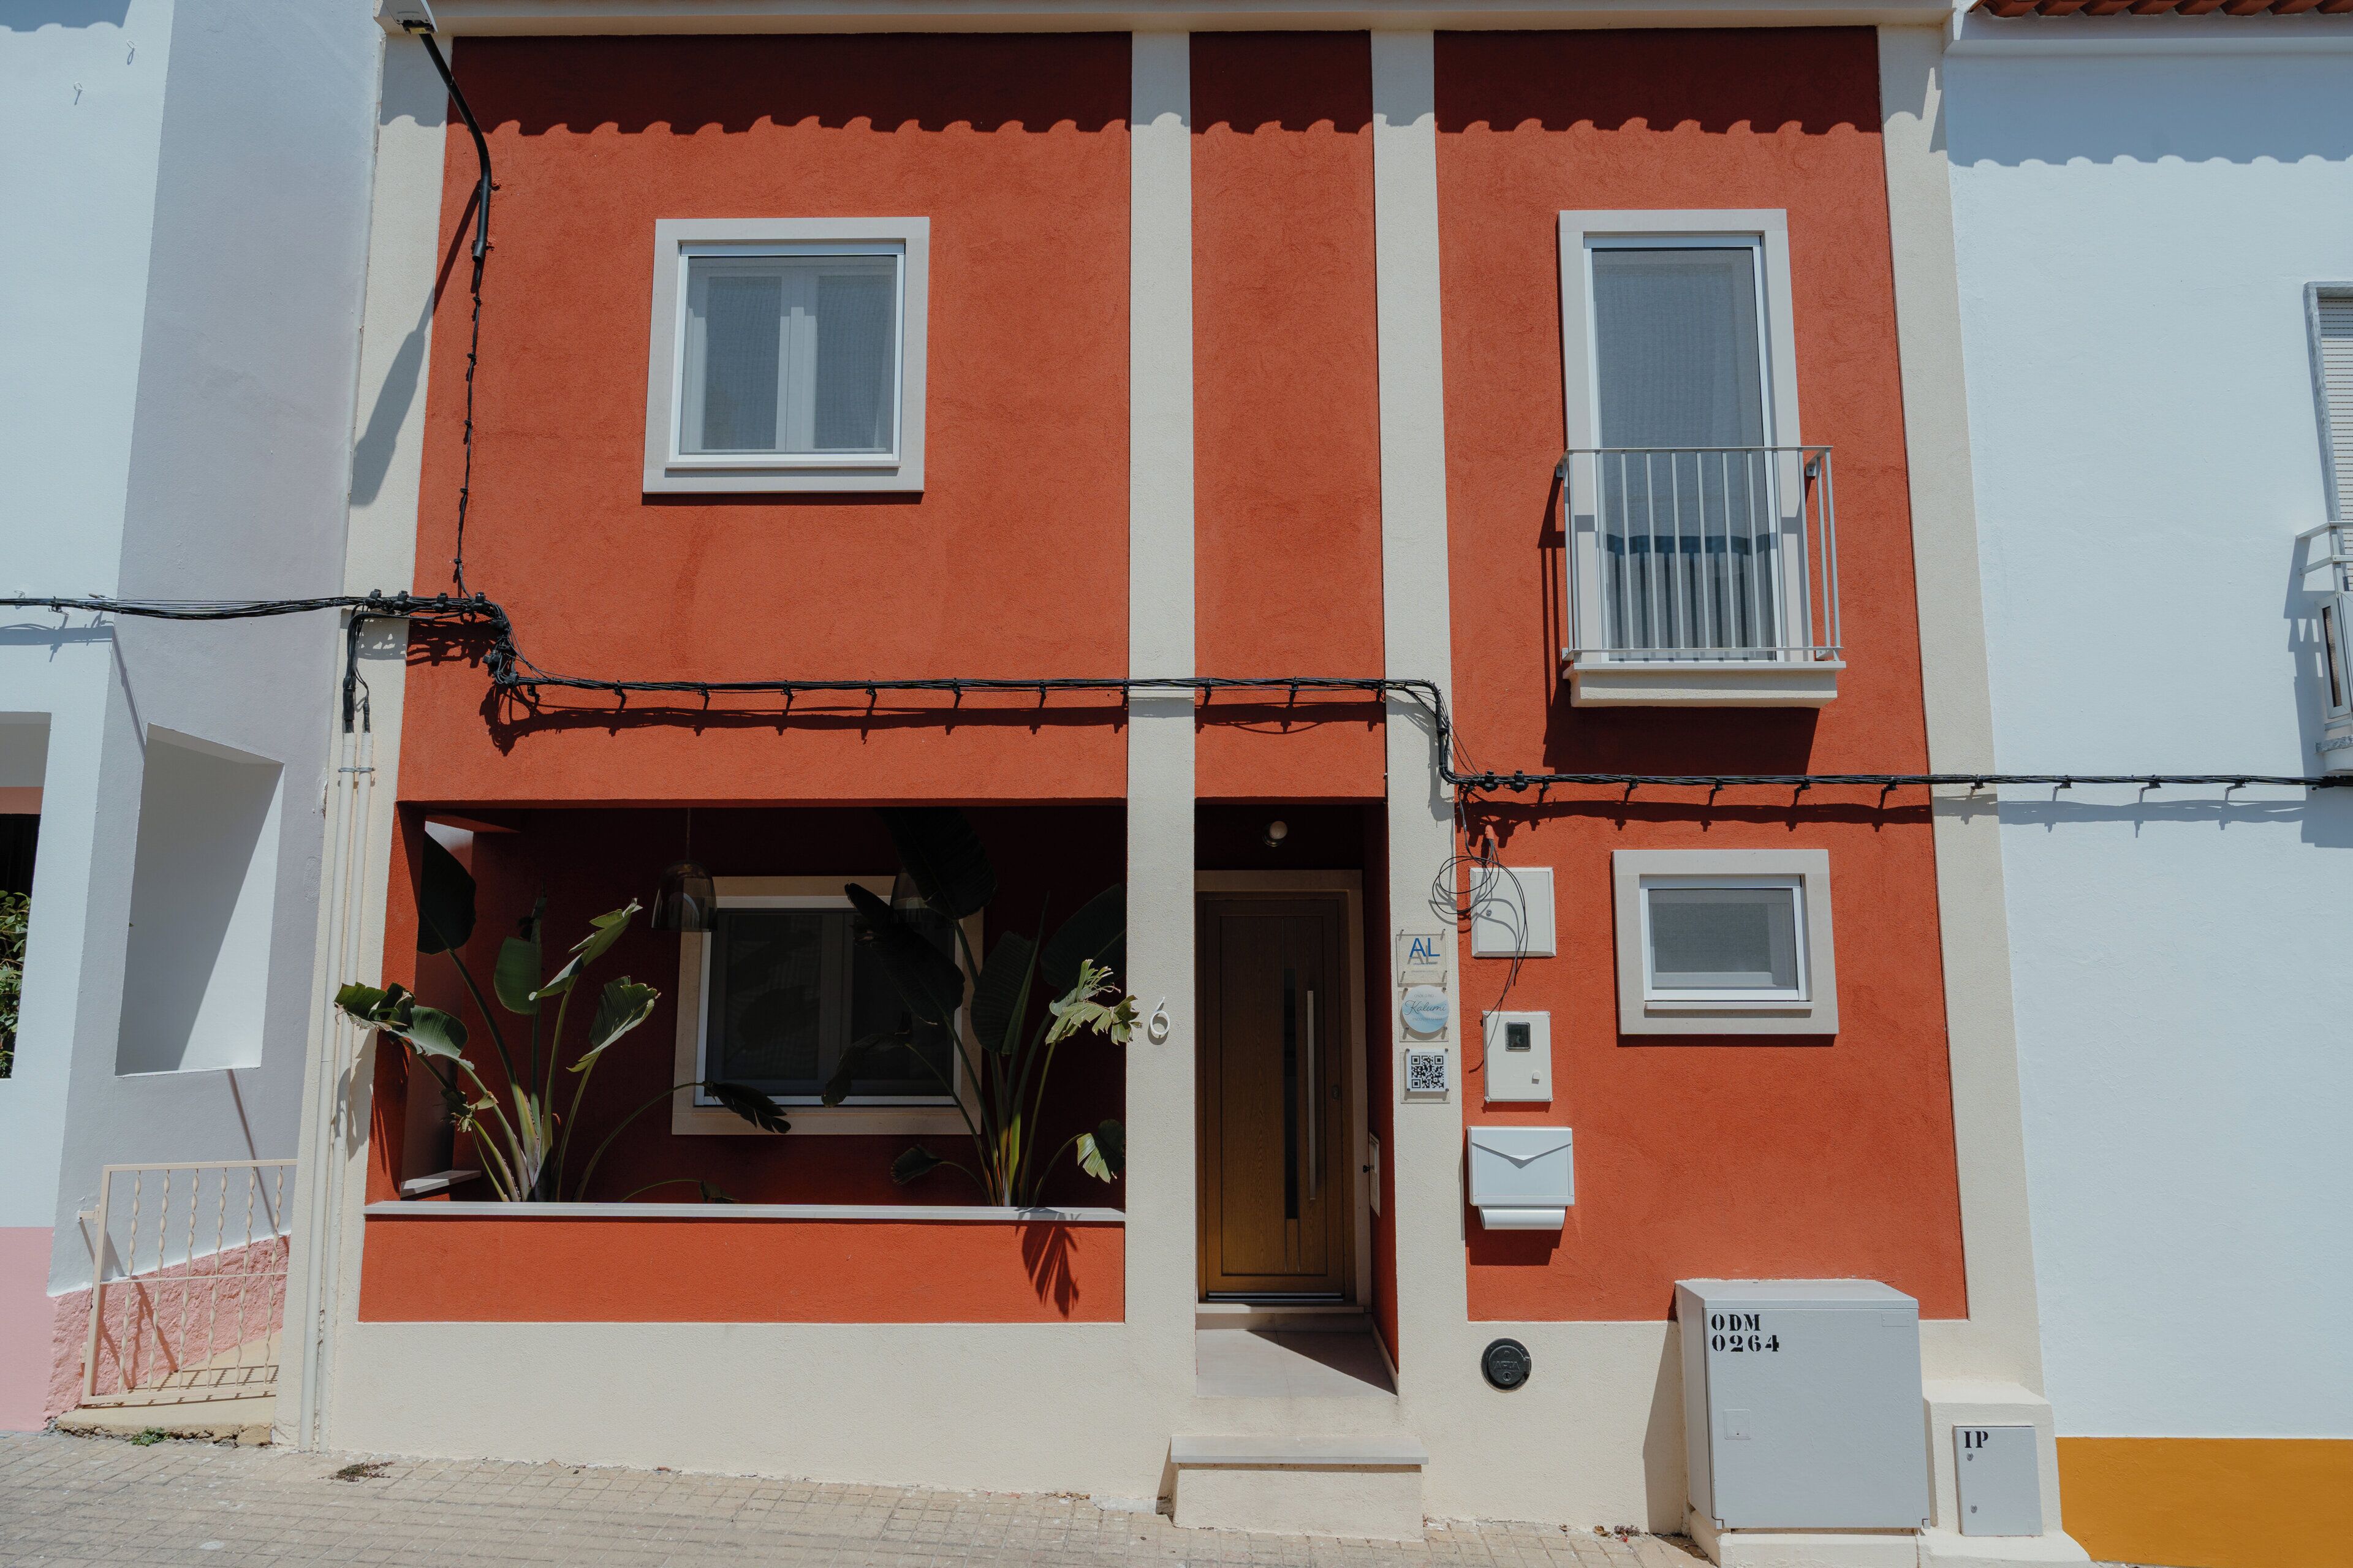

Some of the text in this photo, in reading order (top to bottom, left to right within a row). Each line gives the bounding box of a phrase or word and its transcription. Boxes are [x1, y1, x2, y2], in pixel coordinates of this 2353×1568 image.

[1409, 937, 1441, 958] AL
[1404, 1000, 1447, 1015] Kalumi
[1150, 996, 1170, 1037] 6
[1711, 1314, 1761, 1331] ODM
[1711, 1335, 1779, 1352] 0264
[1964, 1431, 1989, 1448] IP
